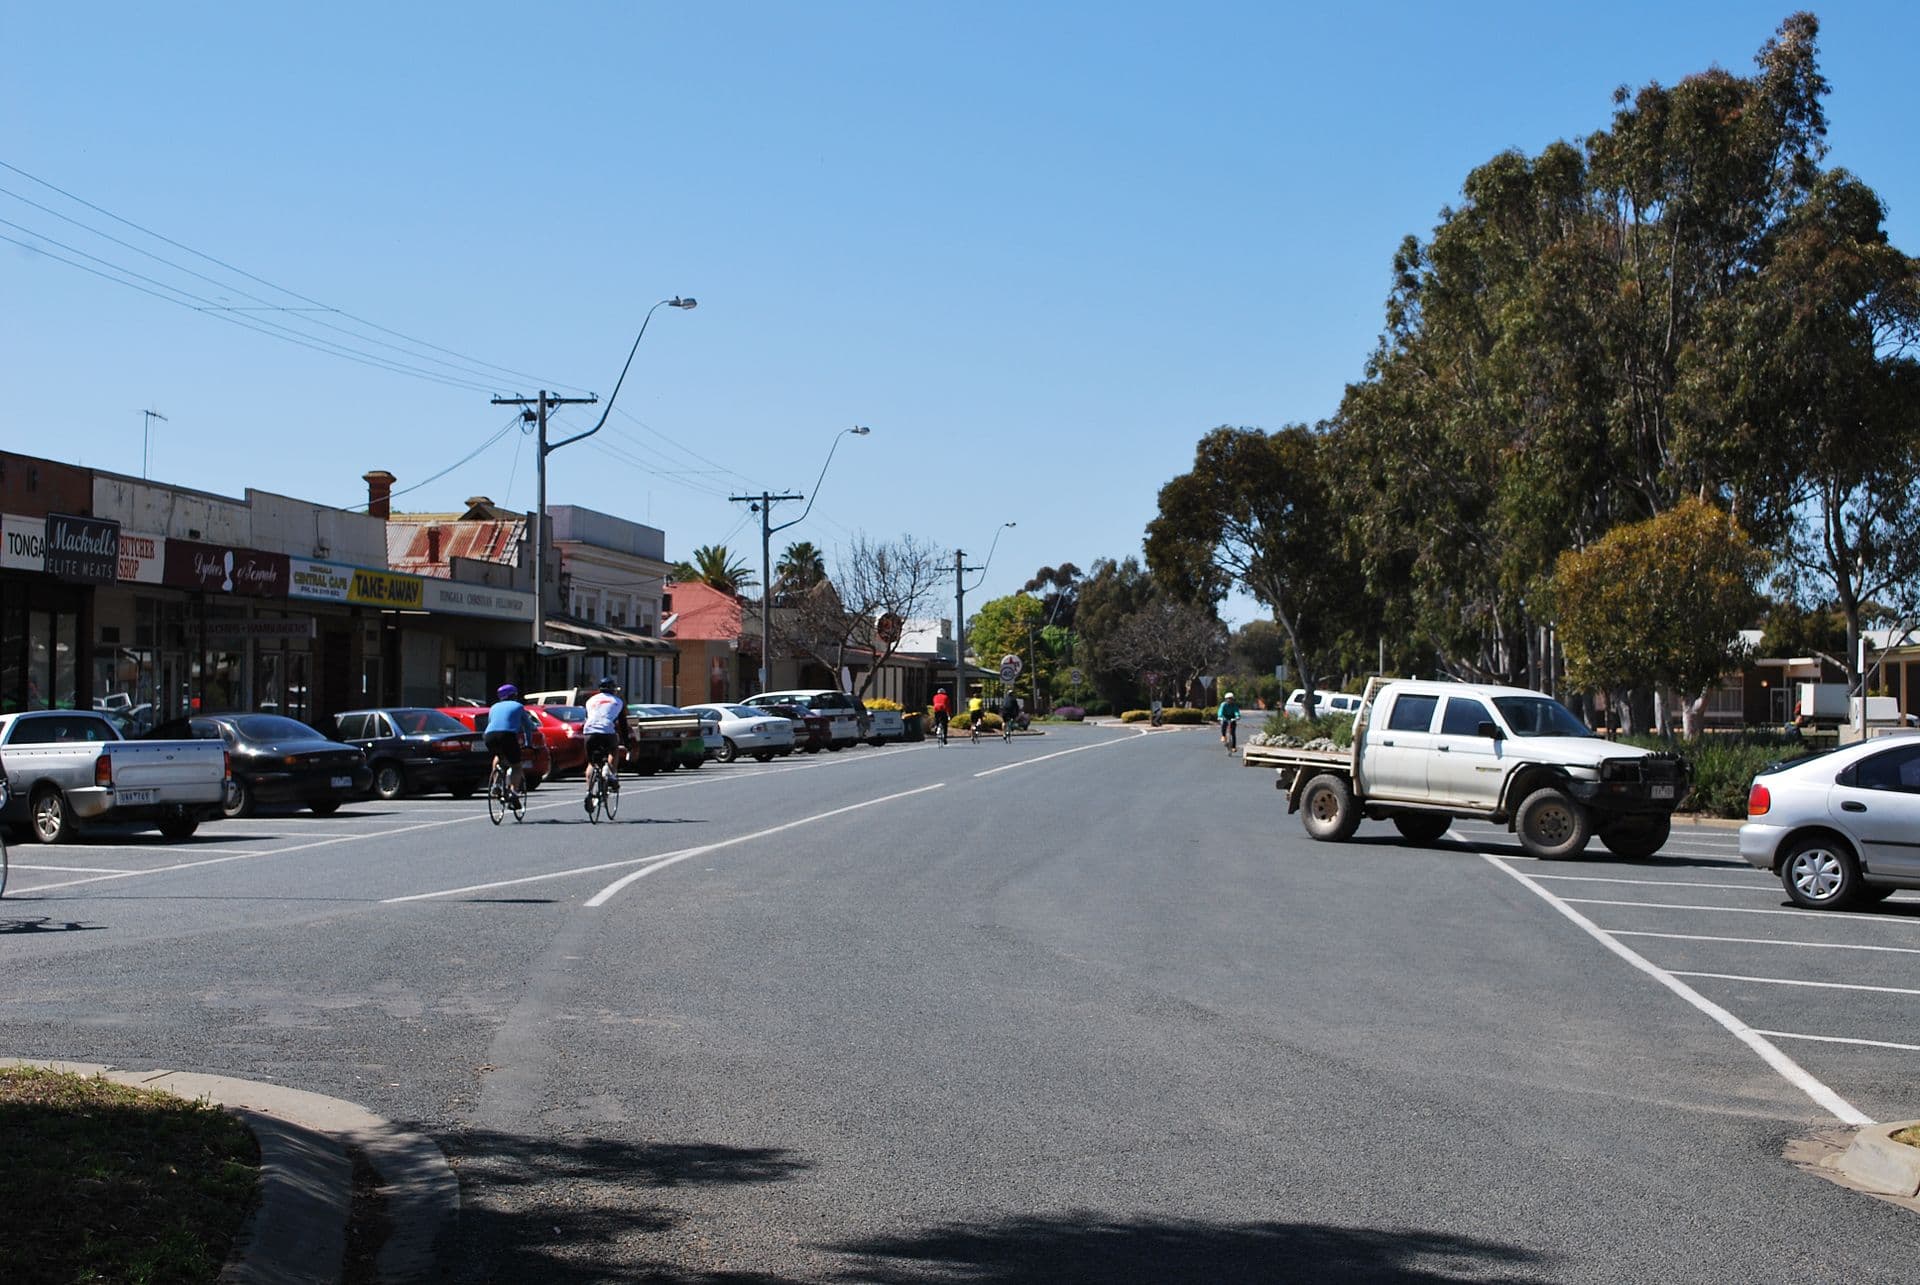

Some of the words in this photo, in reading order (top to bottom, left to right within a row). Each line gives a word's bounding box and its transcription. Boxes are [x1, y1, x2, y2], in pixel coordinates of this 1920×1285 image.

[120, 536, 155, 560] BUTCHER
[48, 558, 78, 577] ELITE
[82, 560, 113, 579] MEATS
[119, 558, 139, 579] SHOP
[295, 572, 327, 587] CENTRAL
[329, 576, 347, 590] CAFE
[1003, 670, 1012, 678] 40
